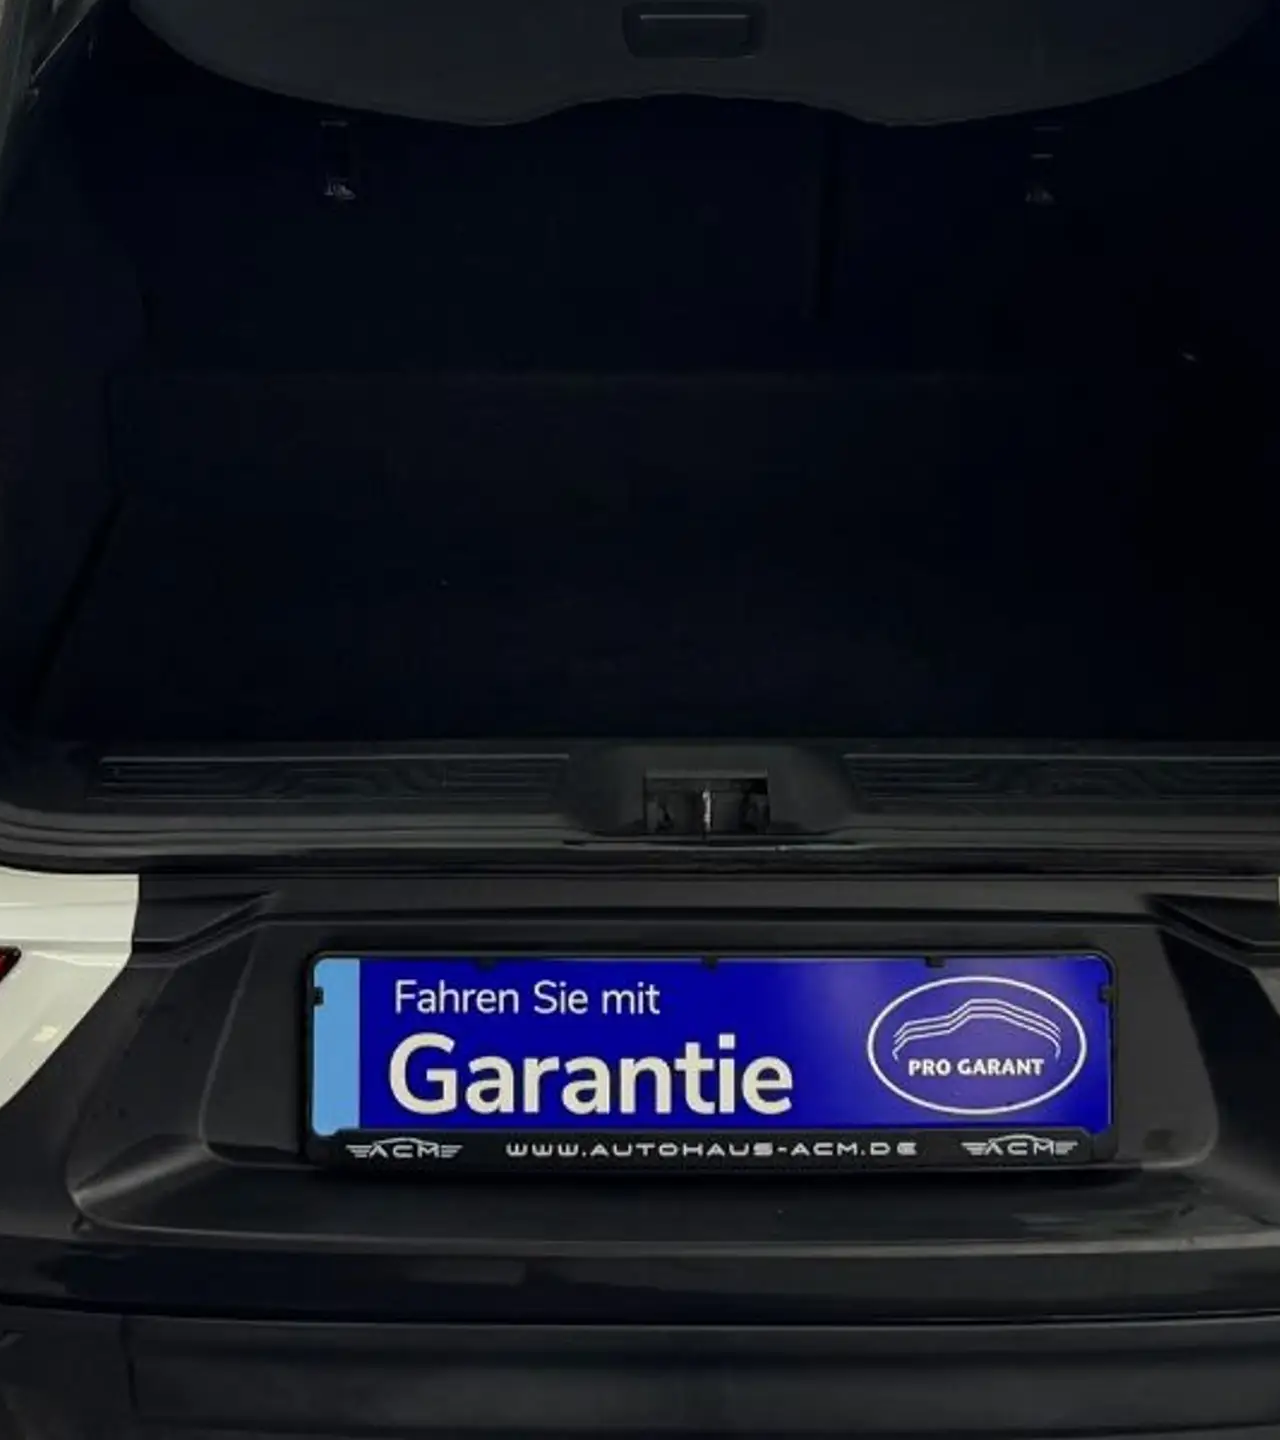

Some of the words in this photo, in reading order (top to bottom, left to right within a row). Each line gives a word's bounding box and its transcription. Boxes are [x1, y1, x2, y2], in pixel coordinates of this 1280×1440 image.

[394, 979, 520, 1014] Fahren
[534, 979, 589, 1015] Sie
[602, 981, 662, 1015] mit
[389, 1032, 794, 1115] Garantie
[908, 1058, 952, 1077] PRO
[956, 1058, 1045, 1077] GARANT
[368, 1143, 440, 1158] ACM
[506, 1142, 917, 1157] WWW.AUTOHAUS-ACM.DE
[984, 1141, 1055, 1157] ACM
